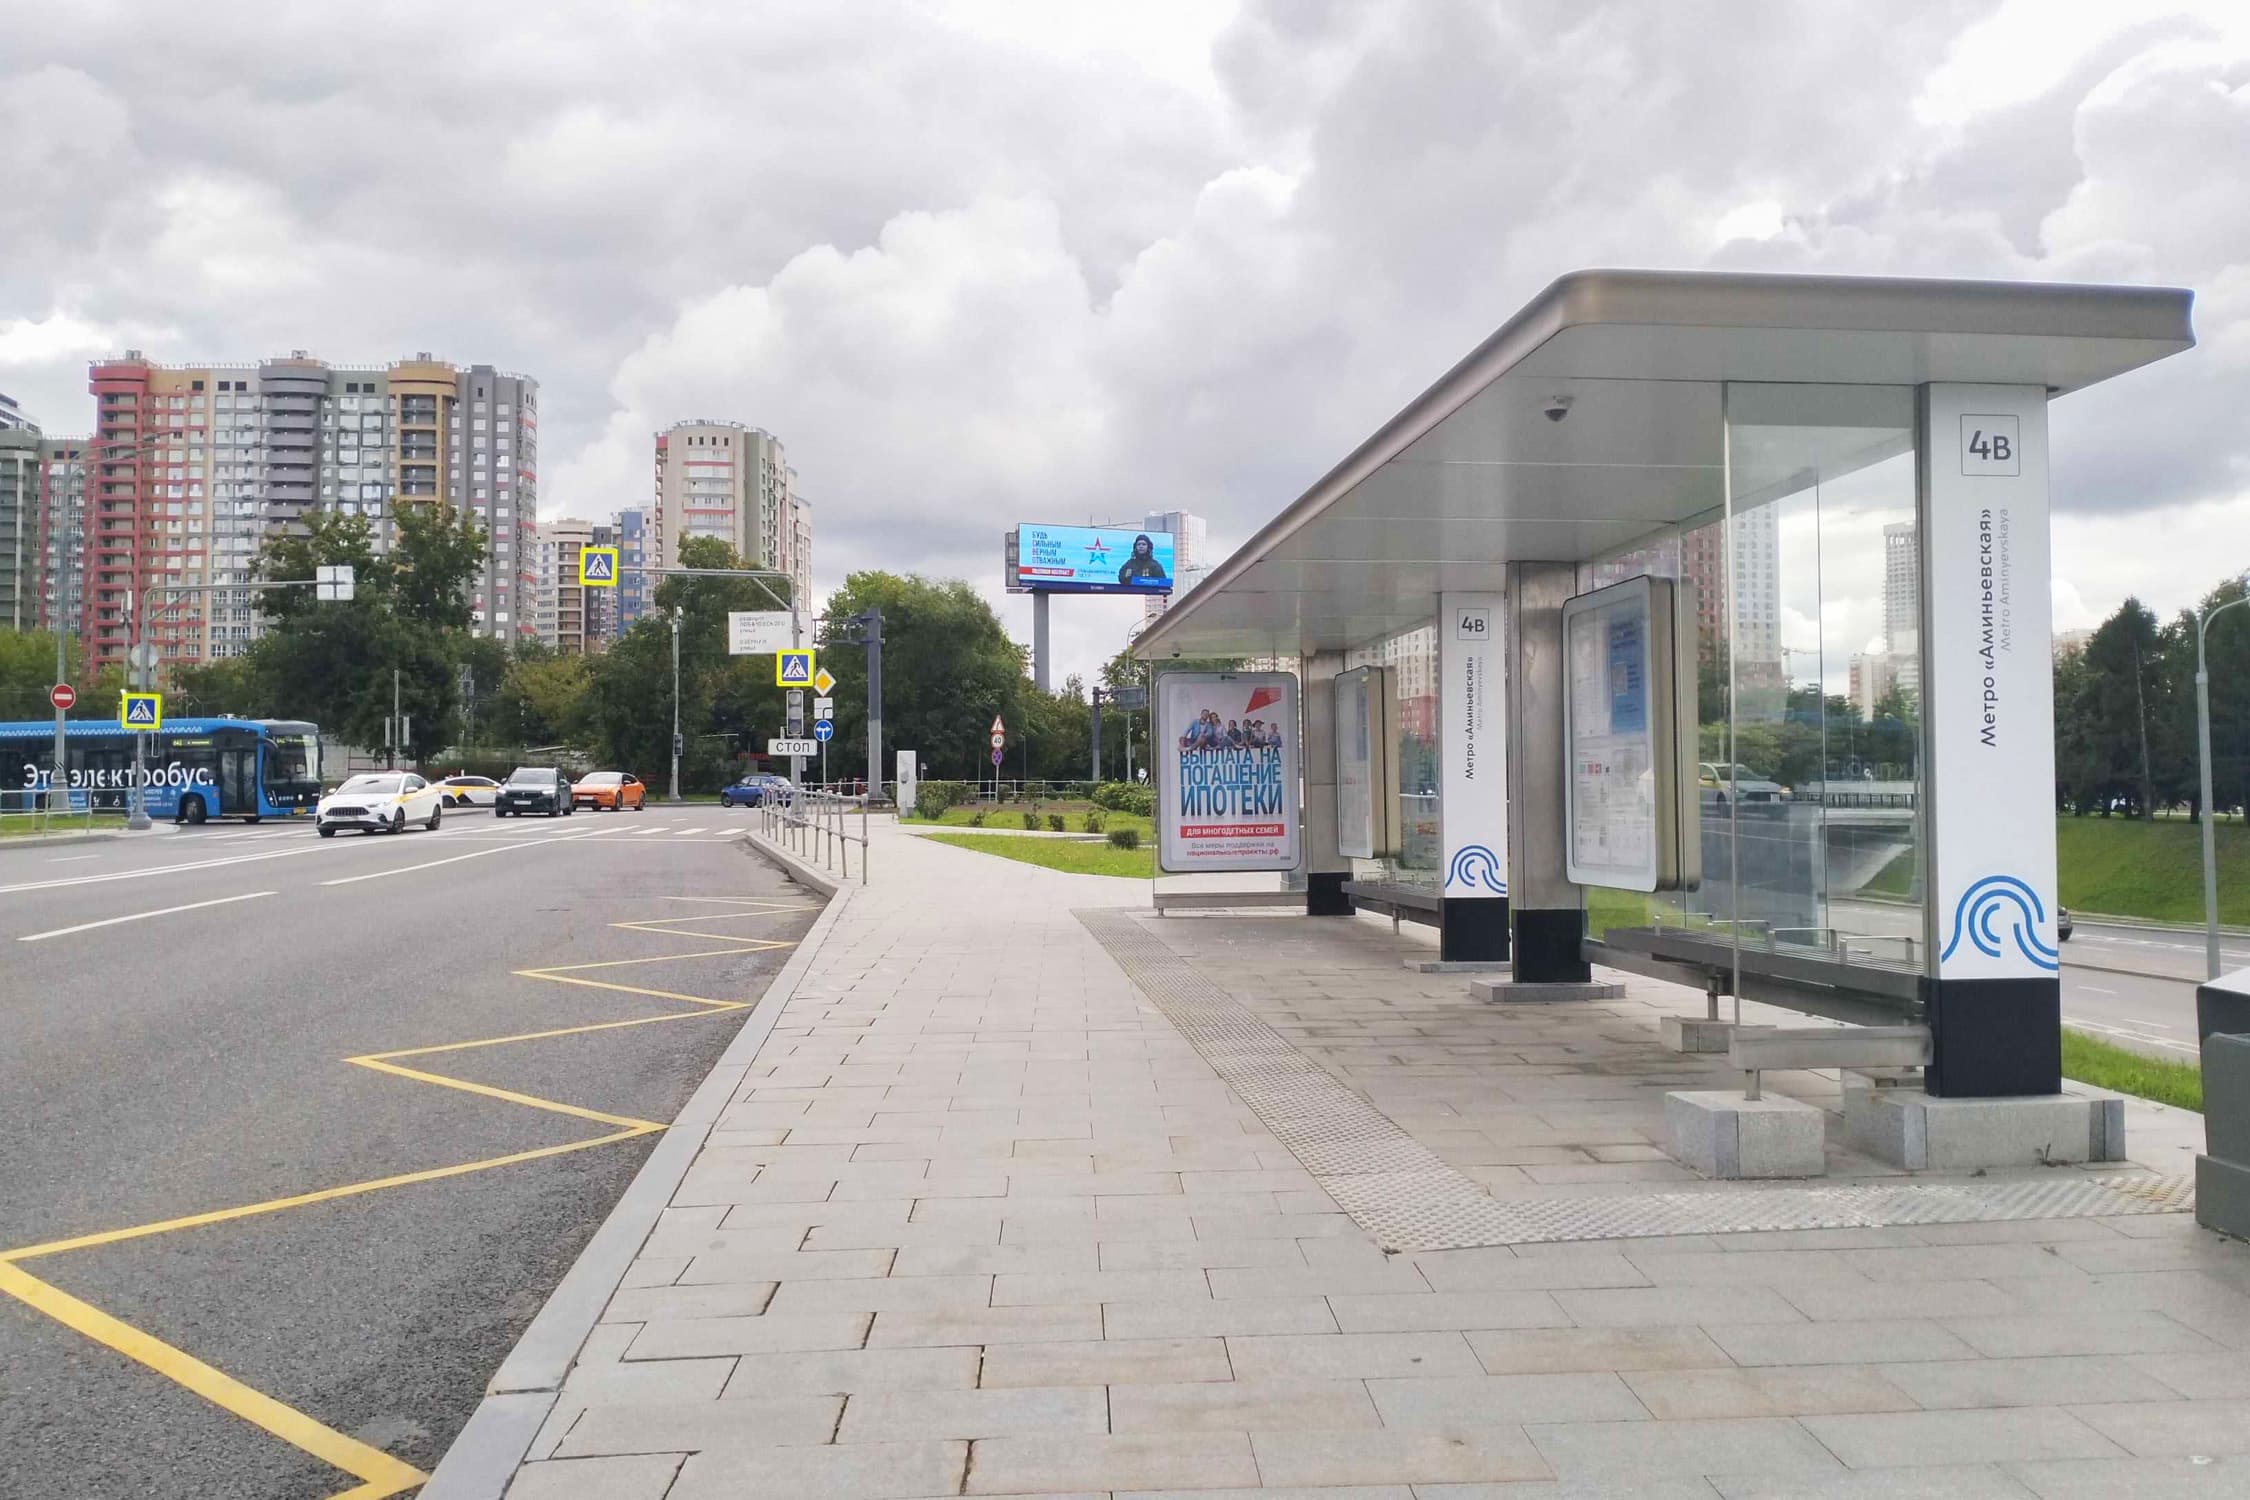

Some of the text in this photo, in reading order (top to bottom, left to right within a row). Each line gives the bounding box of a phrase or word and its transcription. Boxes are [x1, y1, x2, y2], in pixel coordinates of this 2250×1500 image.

[1969, 431, 2011, 461] 4В
[1999, 508, 2011, 651] Metro Aminyevskaya
[1978, 508, 1999, 747] Метро «Аминьевская»
[1464, 656, 1474, 780] Метро «Аминьевская»
[776, 742, 810, 753] СТОП
[993, 737, 1002, 745] 40
[1180, 746, 1282, 764] ВЫПЛАТА НА
[23, 763, 55, 788] Эт
[1180, 764, 1282, 785] ПОГАШЕНИЕ
[1181, 784, 1283, 817] ИПОТЕКИ
[1186, 825, 1280, 836] ДЛЯ МНОГОДЕТНЫХ СЕМЕЙ
